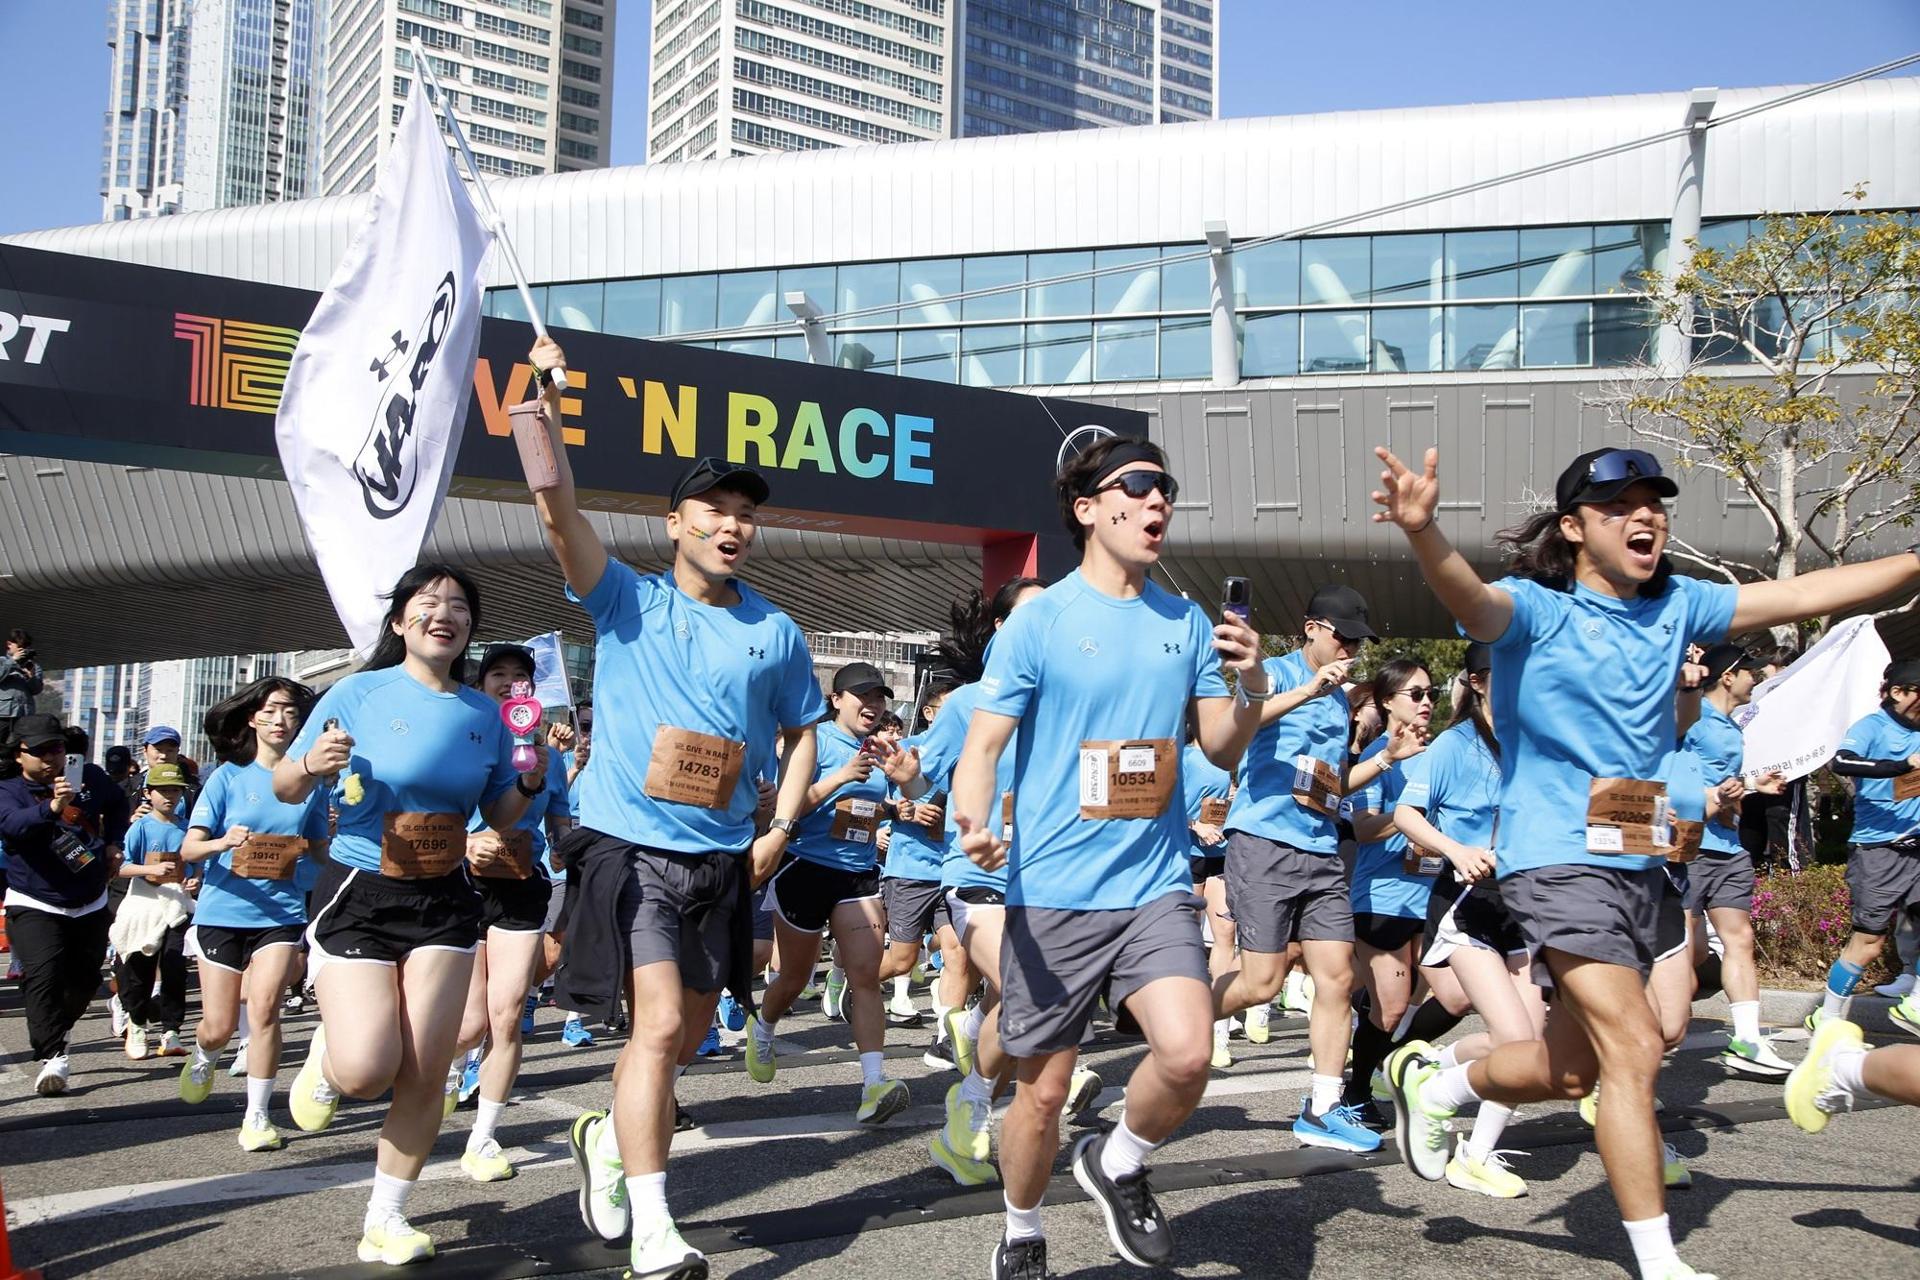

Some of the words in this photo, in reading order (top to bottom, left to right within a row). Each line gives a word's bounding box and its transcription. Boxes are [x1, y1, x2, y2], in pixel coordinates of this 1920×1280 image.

[473, 357, 587, 446] VE
[727, 391, 934, 485] RACE
[677, 759, 720, 778] 14783
[1111, 772, 1156, 786] 10534
[408, 839, 447, 850] 17696
[253, 851, 280, 861] 19141
